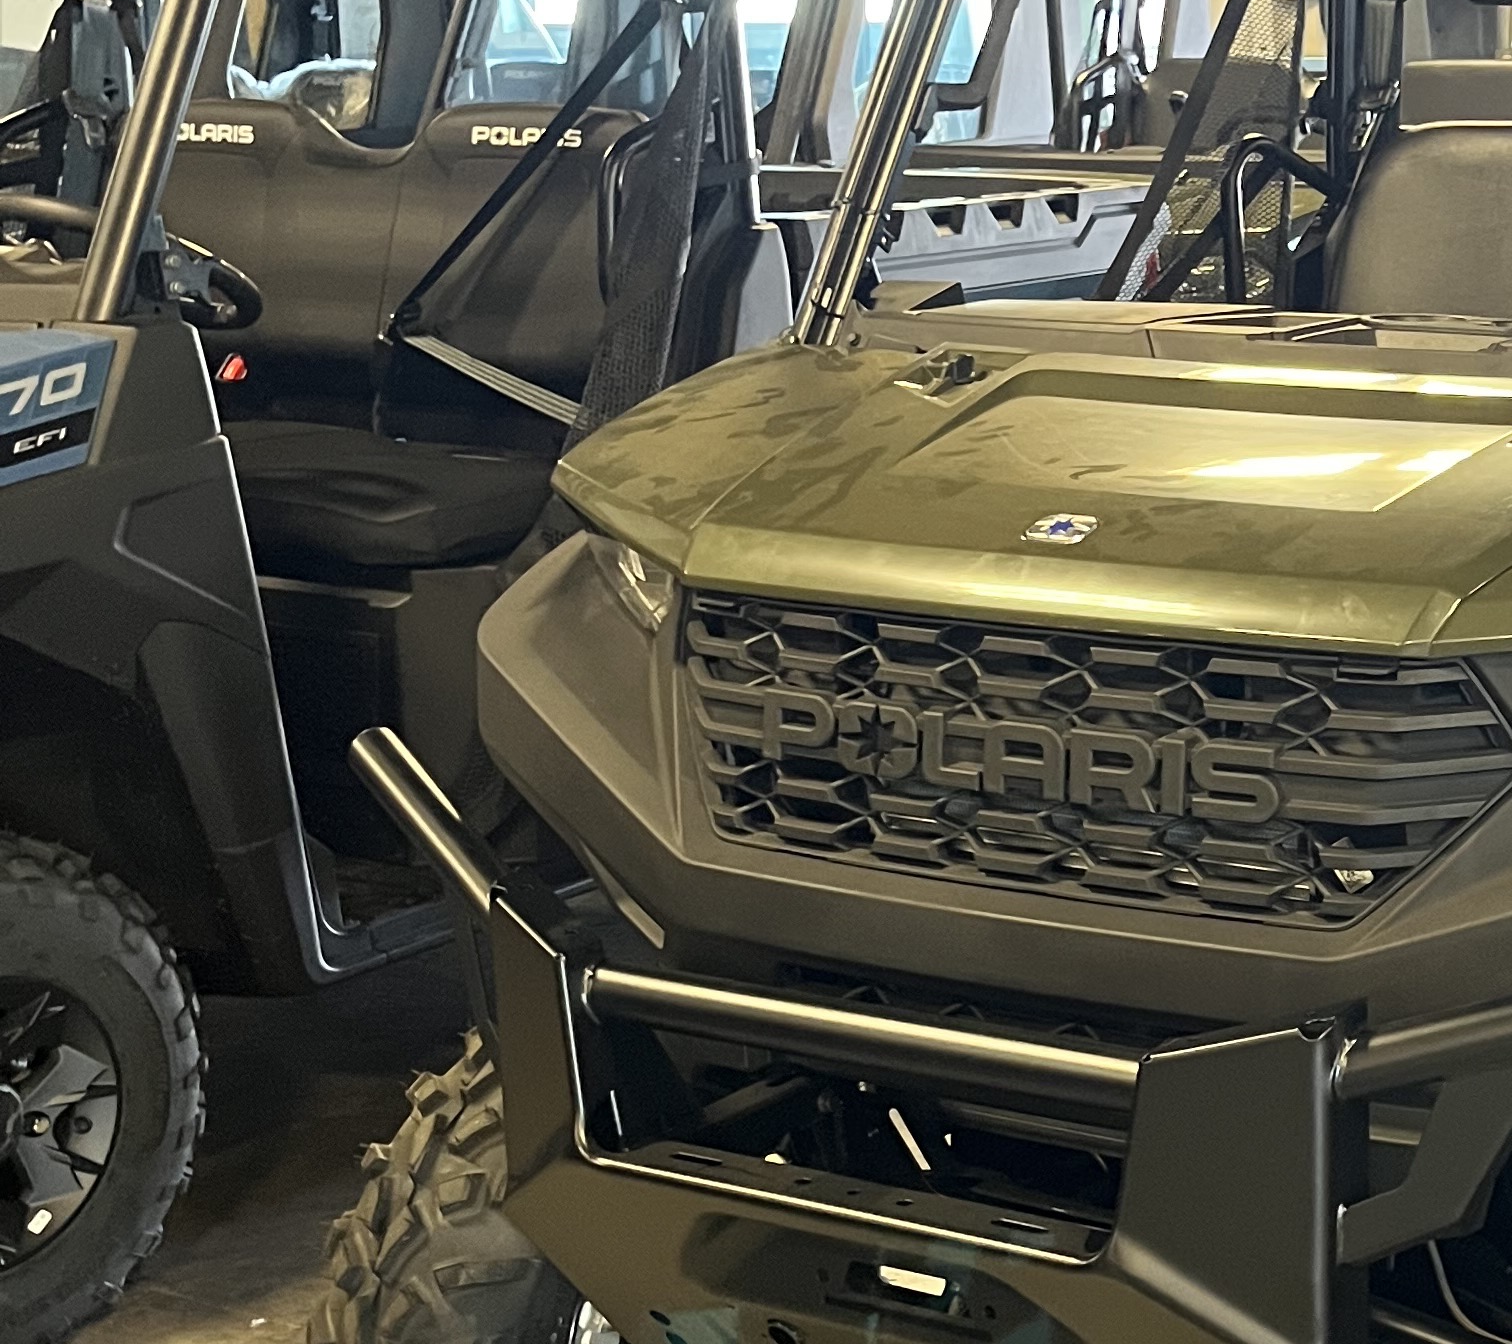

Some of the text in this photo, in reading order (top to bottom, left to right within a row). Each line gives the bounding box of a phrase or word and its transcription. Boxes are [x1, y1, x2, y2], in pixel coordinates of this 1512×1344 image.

[176, 122, 255, 145] OLARIS
[470, 125, 582, 148] POLAS
[13, 427, 67, 455] EFI
[761, 688, 1284, 824] POLARIS
